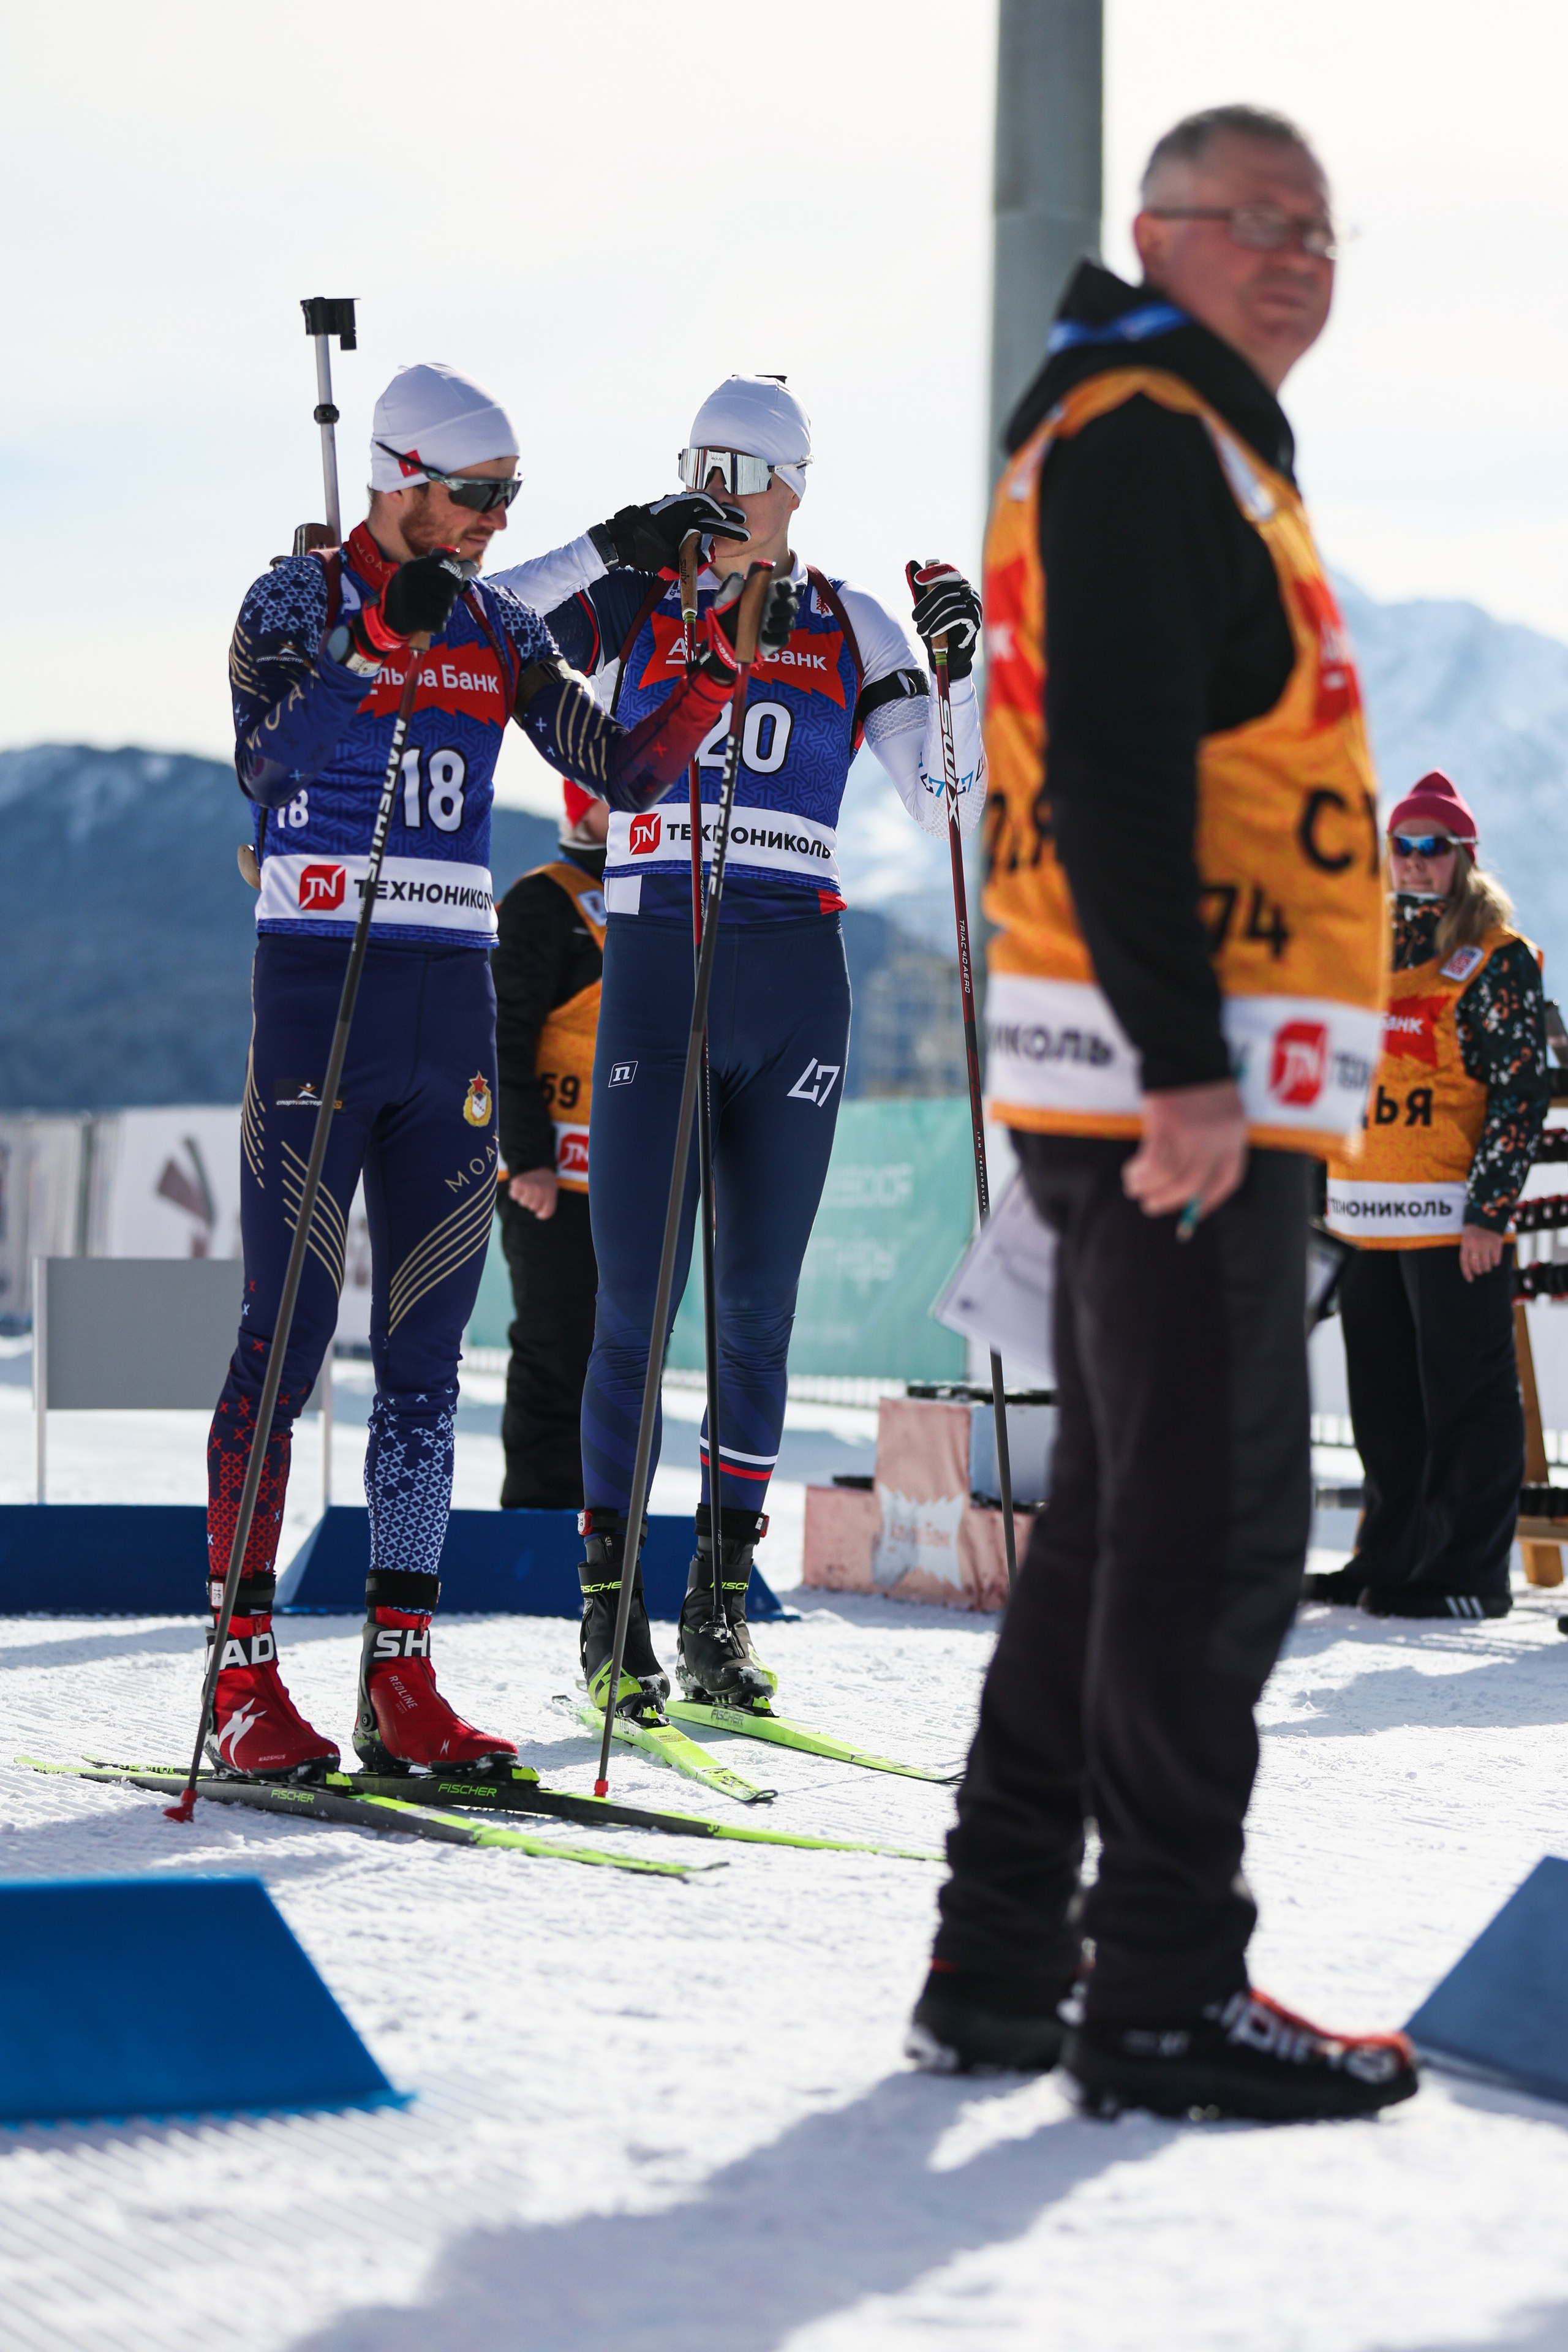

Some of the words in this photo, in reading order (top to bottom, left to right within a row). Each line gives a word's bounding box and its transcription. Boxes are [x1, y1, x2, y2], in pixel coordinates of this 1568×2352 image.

[371, 666, 439, 688] льа
[441, 664, 500, 695] Банк
[694, 701, 793, 774] 20
[401, 747, 466, 833] 18
[277, 789, 309, 829] 18
[353, 879, 493, 911] ТЕХНОНИКОЛ
[1365, 1085, 1433, 1128] ЬЯ
[979, 1155, 987, 1212] TECHNOLOGY
[373, 1629, 429, 1657] SH
[389, 1675, 418, 1709] REDLINE
[711, 1708, 744, 1726] FISCHER
[270, 1789, 315, 1804] FISCHER
[438, 1783, 498, 1798] FISCHER
